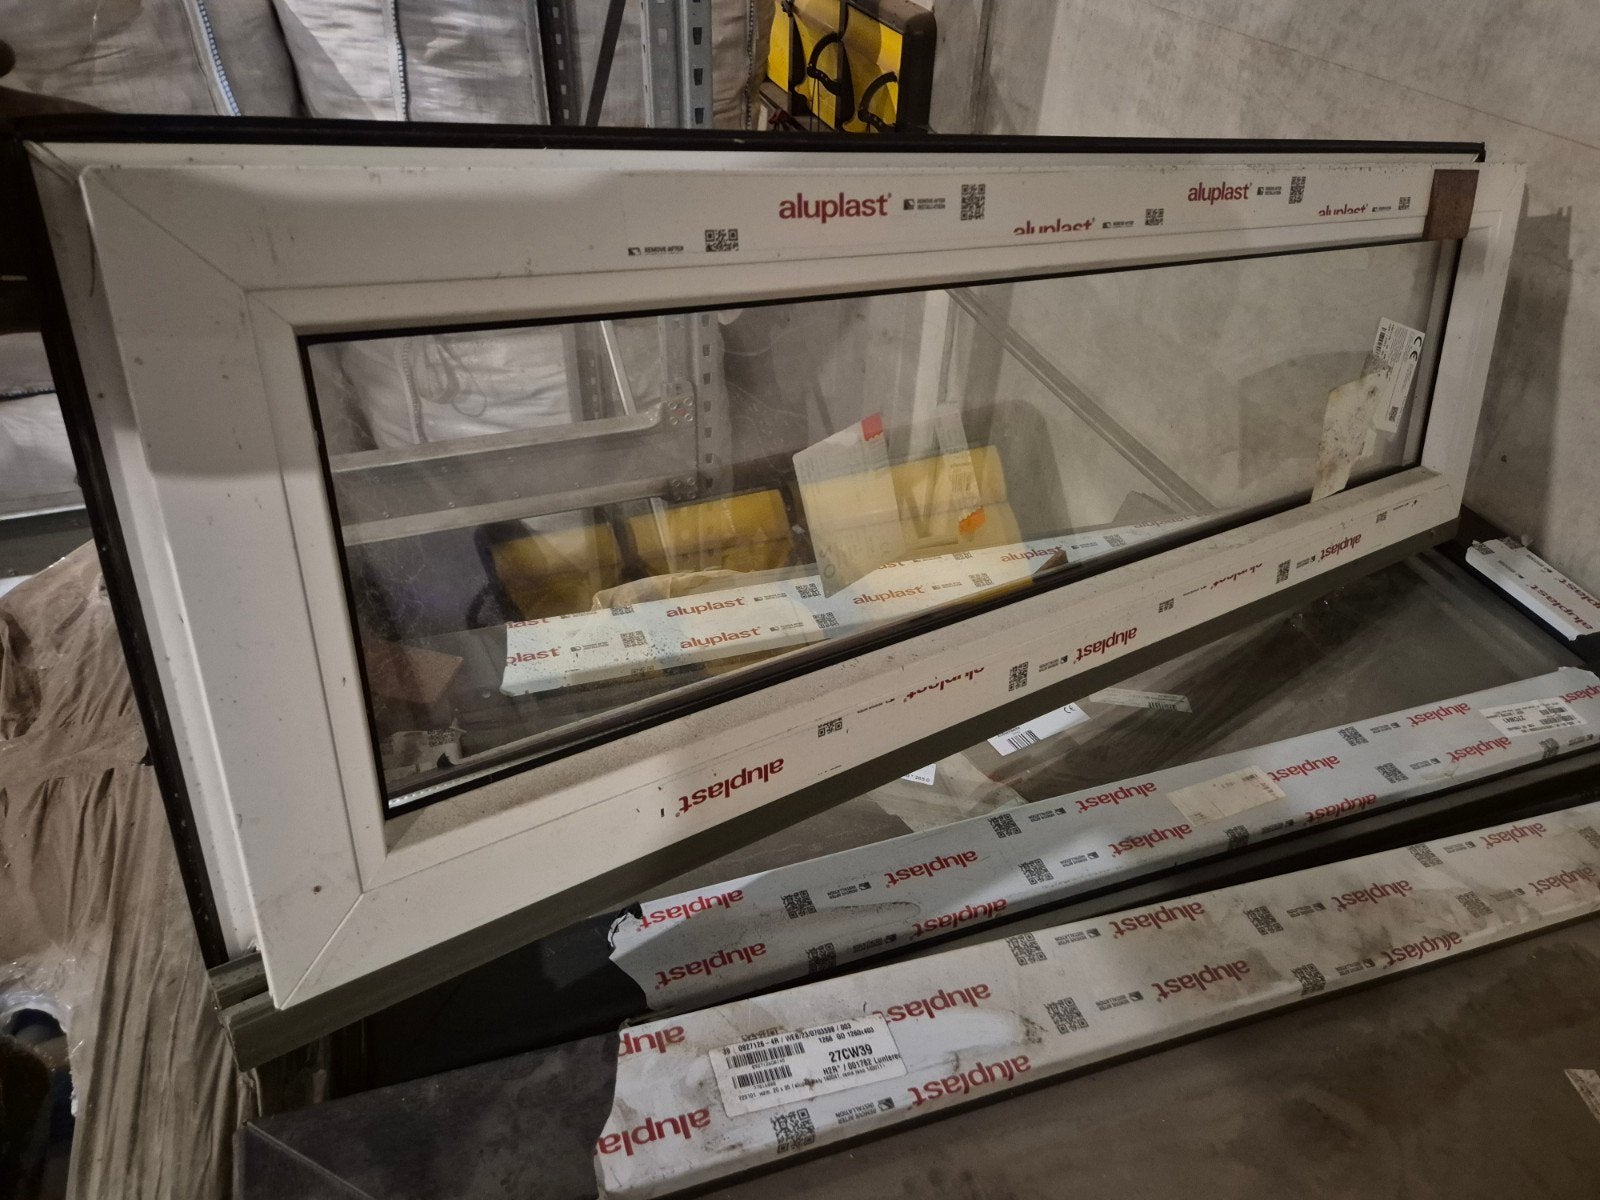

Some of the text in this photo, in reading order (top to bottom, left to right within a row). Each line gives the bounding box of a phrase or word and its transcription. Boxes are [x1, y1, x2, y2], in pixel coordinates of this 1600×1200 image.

[779, 192, 891, 224] aluplast
[1187, 182, 1252, 206] aluplast
[666, 595, 746, 618] aluplast
[680, 626, 761, 651] aluplast
[1073, 627, 1138, 663] aluplast
[1410, 703, 1471, 728] aluplast
[1446, 737, 1512, 764] aluplast
[1269, 755, 1340, 783] aluplast
[677, 758, 785, 818] aluplast
[1076, 782, 1157, 814] aluplast
[1110, 824, 1193, 857] aluplast
[1483, 822, 1547, 849] aluplast
[885, 850, 979, 889] aluplast
[636, 888, 744, 933] aluplast
[1331, 880, 1413, 912] aluplast
[911, 898, 1008, 941] aluplast
[1111, 901, 1206, 939] aluplast
[655, 943, 767, 990] aluplast
[1382, 931, 1463, 970] aluplast
[1151, 959, 1251, 1002] aluplast
[828, 1043, 873, 1063] 27CW39
[908, 1054, 1032, 1110] aluplast
